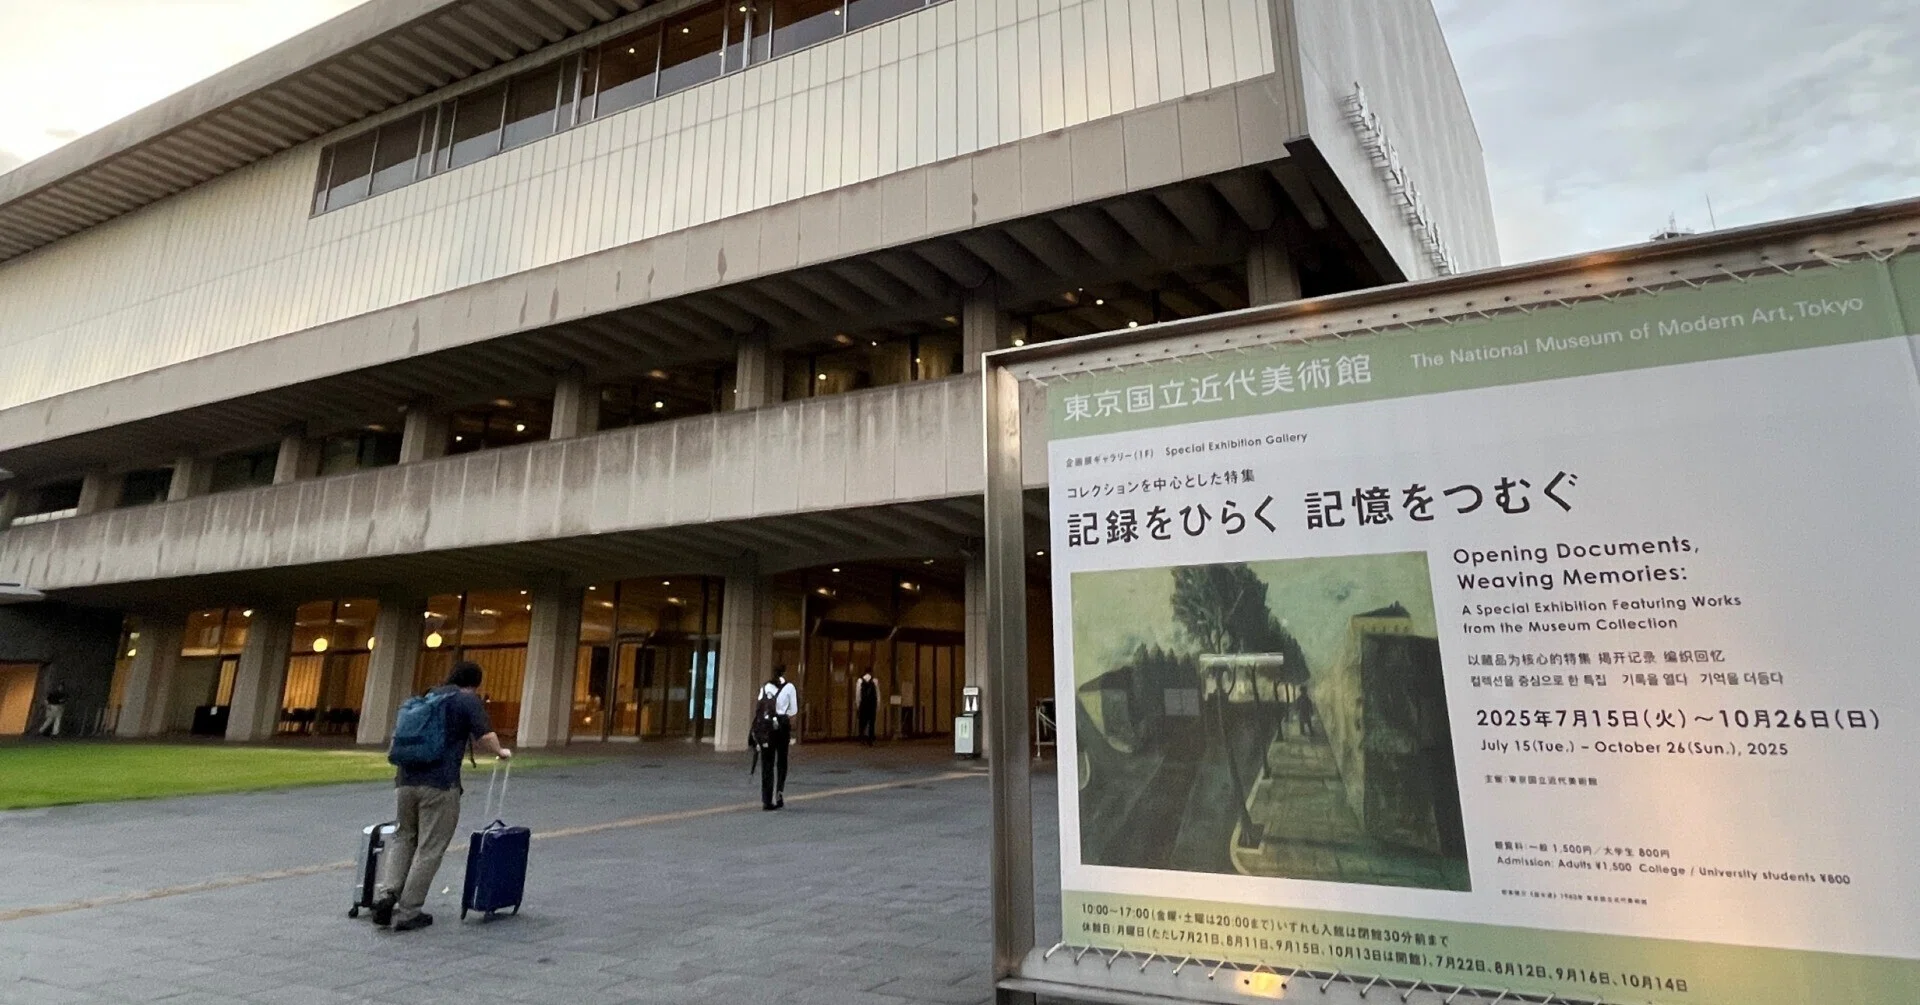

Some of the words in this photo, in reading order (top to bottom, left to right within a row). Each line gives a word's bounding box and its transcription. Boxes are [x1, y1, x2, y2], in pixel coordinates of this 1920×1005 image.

[1410, 353, 1444, 369] The
[1450, 340, 1528, 364] National
[1536, 328, 1623, 352] Museum
[1630, 322, 1650, 340] of
[1658, 313, 1744, 337] Modern
[1063, 354, 1371, 422] 東京国立近代美術館
[1165, 442, 1205, 457] Special
[1208, 437, 1261, 451] Exhibition
[1265, 432, 1308, 446] Gallery
[1067, 469, 1255, 499] コレクションを中心とした特集
[1067, 495, 1276, 547] 記録をひらく
[1304, 470, 1578, 529] 記憶をつむぐ
[1453, 545, 1548, 567] Opening
[1557, 536, 1699, 559] Documents,
[1457, 571, 1554, 590] Weaving
[1563, 565, 1687, 585] Memories:
[1462, 605, 1471, 615] A
[1477, 602, 1529, 617] Special
[1535, 600, 1606, 613] Exhibition
[1612, 598, 1686, 611] Featuring
[1691, 595, 1741, 608] Works
[1463, 623, 1495, 634] from
[1500, 622, 1523, 633] the
[1529, 620, 1590, 632] Museum
[1596, 617, 1677, 631] Collection
[1568, 674, 1578, 687] 한
[1481, 740, 1508, 754] July
[1515, 740, 1575, 754] 15(Tue.)
[1595, 740, 1661, 754] October
[1747, 742, 1788, 755] 2025
[1639, 847, 1671, 859] 800円
[1497, 856, 1553, 867] Admission:
[1558, 859, 1592, 870] Adults
[1596, 861, 1632, 872] ¥1,500
[1639, 864, 1685, 877] College
[1699, 867, 1757, 881] University
[1763, 871, 1815, 882] students
[1820, 873, 1850, 885] ¥800
